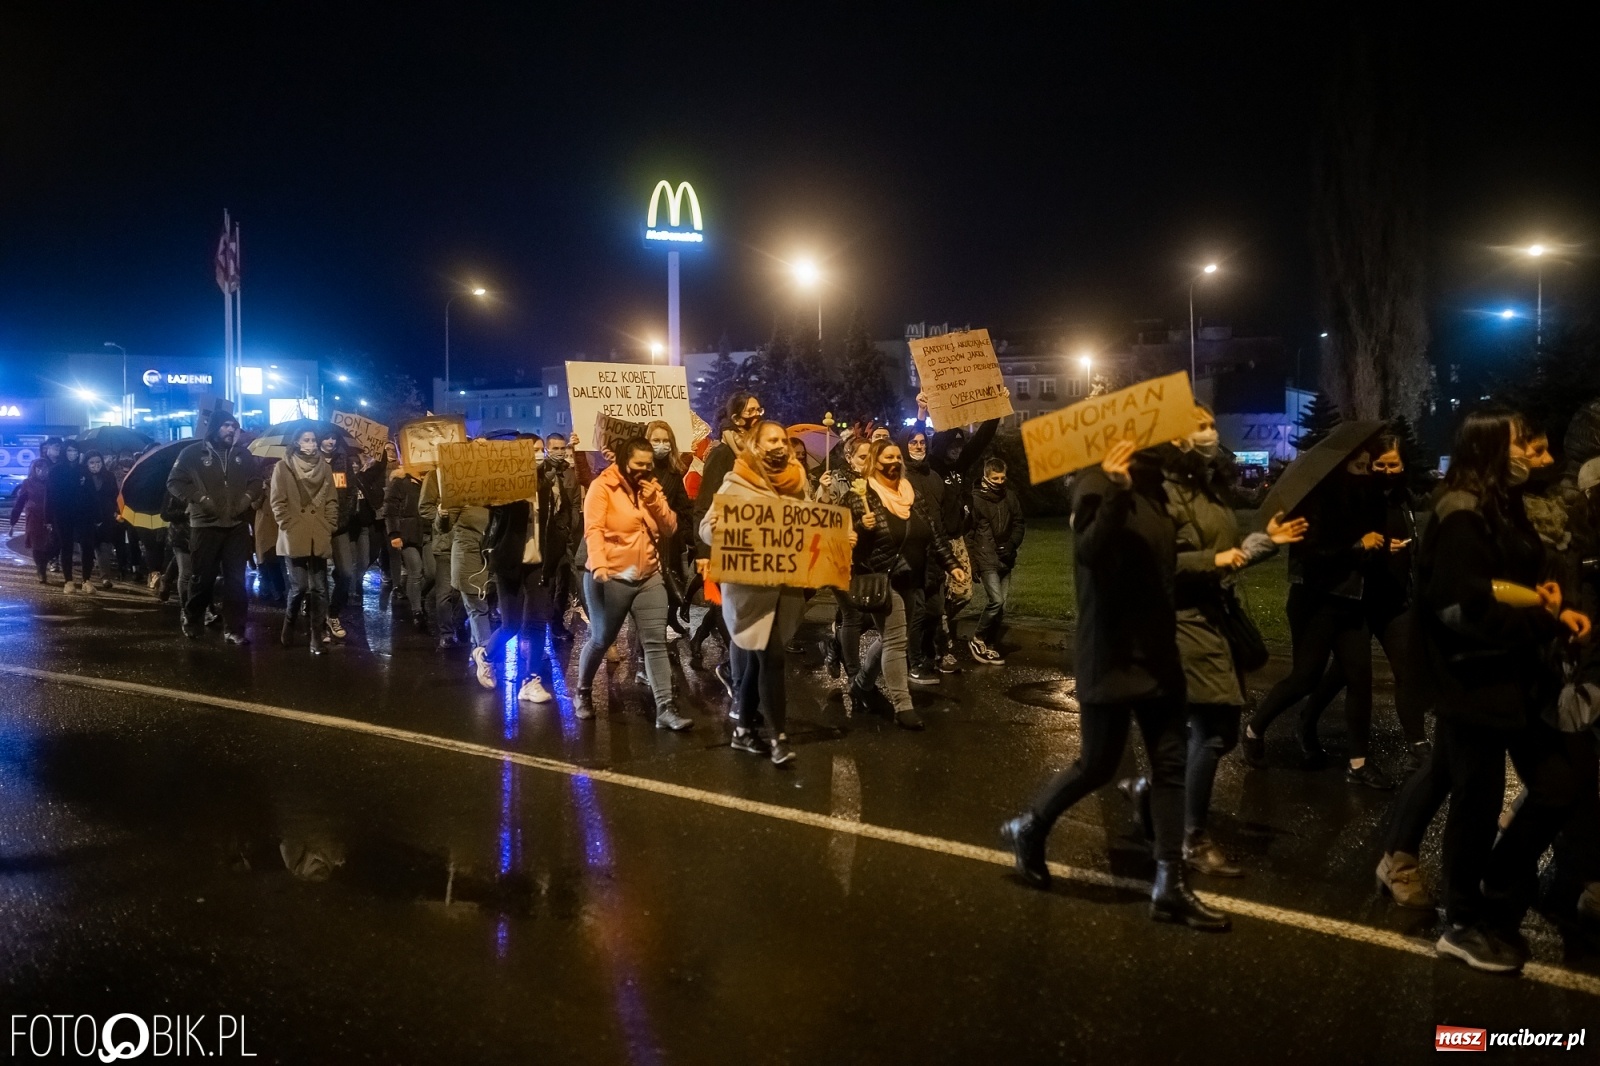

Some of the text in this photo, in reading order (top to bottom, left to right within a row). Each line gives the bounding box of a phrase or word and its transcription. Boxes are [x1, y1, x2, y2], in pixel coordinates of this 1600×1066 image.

[167, 374, 213, 385] ŁAZIENKI
[598, 370, 656, 385] BEZ KOBIET
[572, 384, 688, 404] DALEKO NIE ZAJDZIECIE
[603, 403, 664, 417] BEZ KOBIET
[1026, 383, 1165, 449] NO WOMAN
[1031, 408, 1160, 476] NO KRAJ
[723, 503, 843, 529] MOJA BROSZKA
[723, 526, 804, 552] NIE TWÓJ
[721, 553, 798, 574] INTERES
